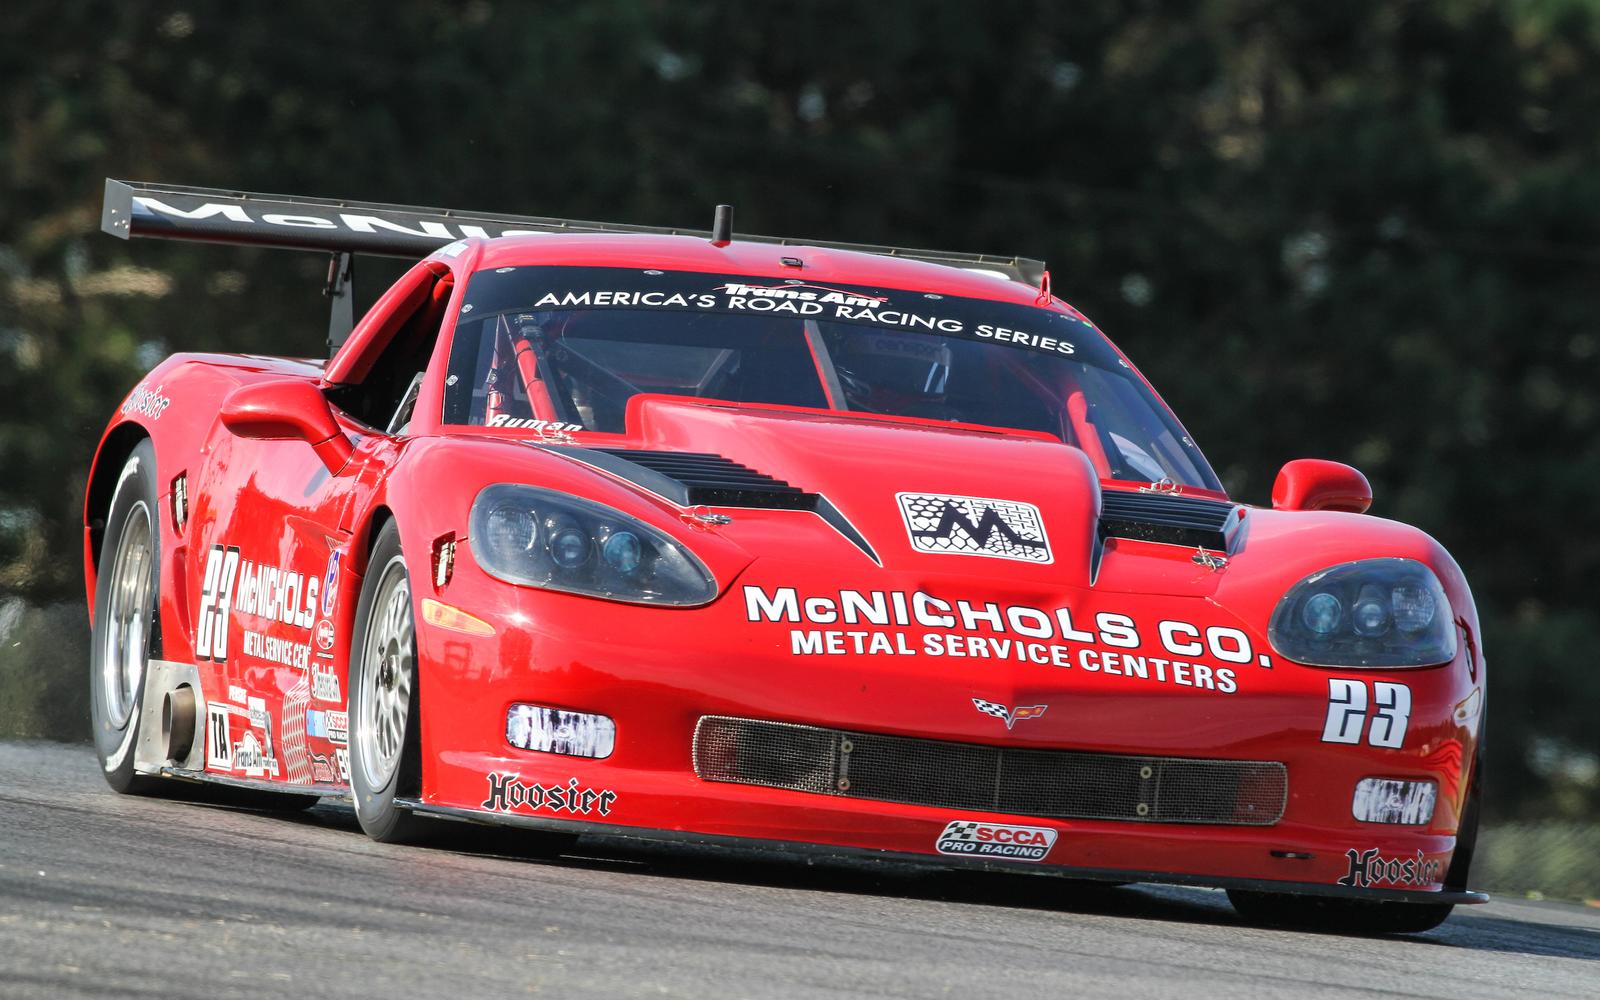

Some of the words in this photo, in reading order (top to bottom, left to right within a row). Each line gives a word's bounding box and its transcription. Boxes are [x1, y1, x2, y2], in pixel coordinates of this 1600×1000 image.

[132, 196, 556, 240] McNI
[724, 283, 818, 301] Trans
[813, 291, 882, 309] Am
[534, 290, 716, 309] AMERICA'S
[728, 296, 824, 315] ROAD
[834, 305, 964, 333] RACING
[976, 324, 1076, 355] SERIES
[486, 413, 583, 432] Ruman
[196, 544, 240, 660] 23
[235, 560, 319, 630] McNICHOLS
[243, 629, 265, 659] METAL
[265, 635, 293, 666] SERVICE
[742, 584, 1142, 650] McNICHOLS
[1157, 620, 1274, 669] CO.
[790, 629, 917, 656] METAL
[922, 633, 1072, 669] SERVICE
[1079, 647, 1238, 694] CENTERS
[211, 712, 229, 760] TA
[1321, 677, 1412, 750] 23
[481, 771, 617, 817] Hoosier
[940, 841, 977, 854] PRO
[980, 844, 1044, 857] RACING
[976, 827, 1049, 846] SCCA
[1336, 848, 1440, 888] Hoosier
